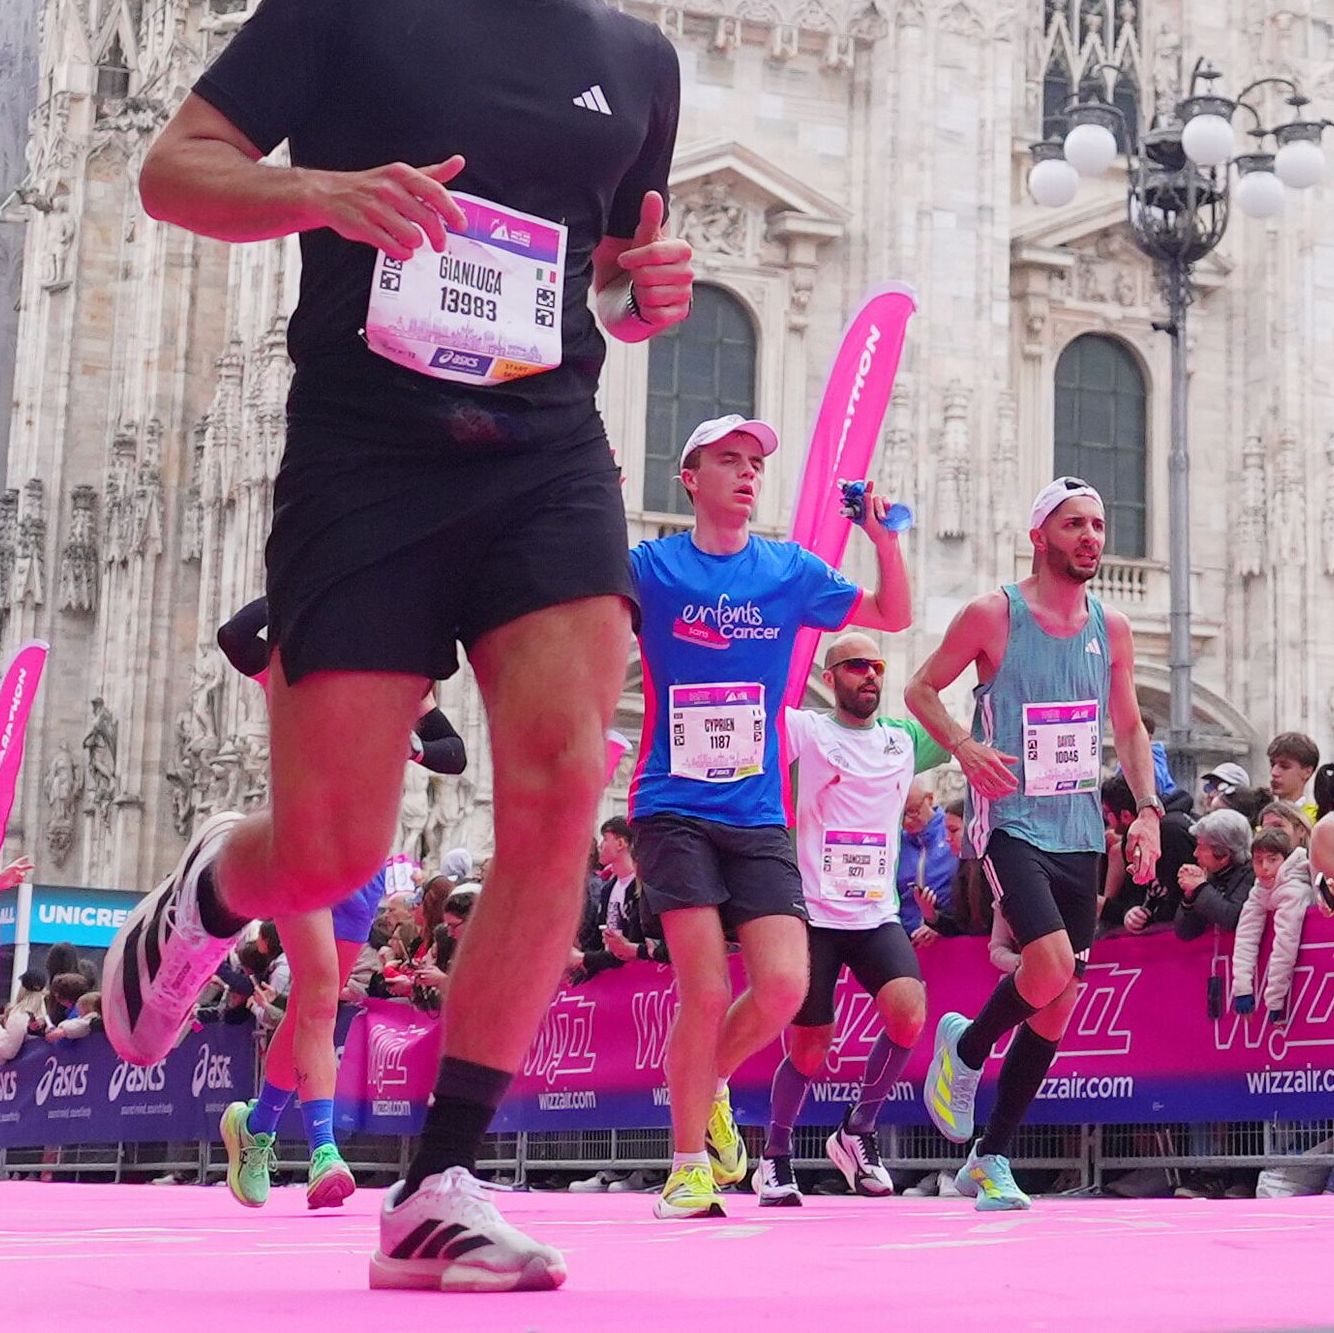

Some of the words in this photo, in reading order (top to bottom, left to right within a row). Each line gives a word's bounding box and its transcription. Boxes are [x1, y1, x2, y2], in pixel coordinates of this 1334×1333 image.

[440, 286, 497, 322] 13983
[682, 593, 763, 629] enfants
[688, 627, 709, 639] sans
[719, 624, 781, 640] Cancer
[704, 718, 735, 733] CYPRIEN
[710, 735, 731, 749] 1187
[38, 904, 131, 928] UNICRE
[1036, 1072, 1134, 1100] zzair.com
[539, 1086, 597, 1111] wizzair.com
